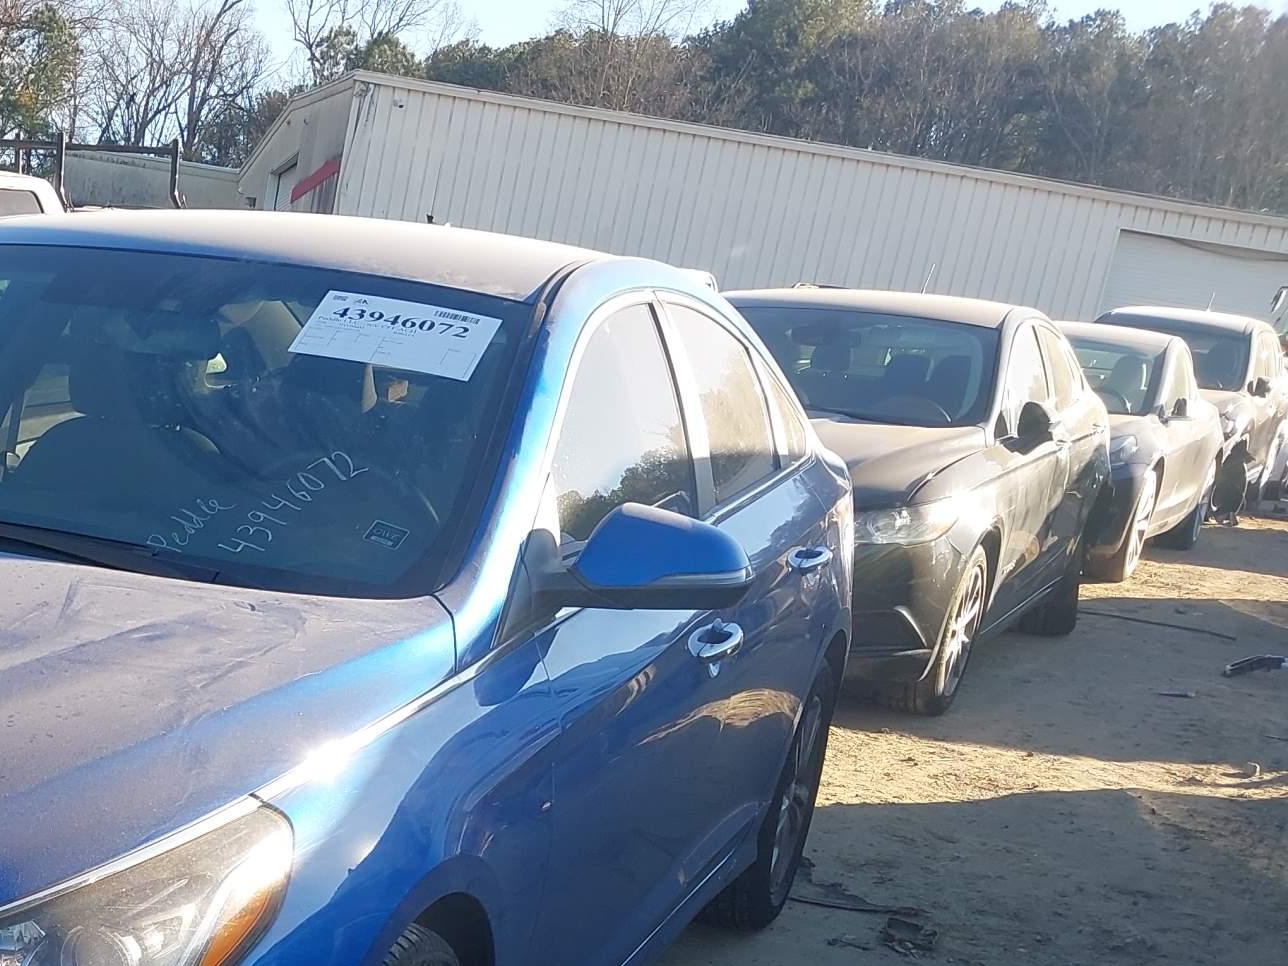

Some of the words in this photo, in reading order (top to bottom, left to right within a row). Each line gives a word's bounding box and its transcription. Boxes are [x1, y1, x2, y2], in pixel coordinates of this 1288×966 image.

[332, 306, 470, 339] 43946072
[145, 499, 235, 553] Peddle
[218, 451, 369, 553] 43946072
